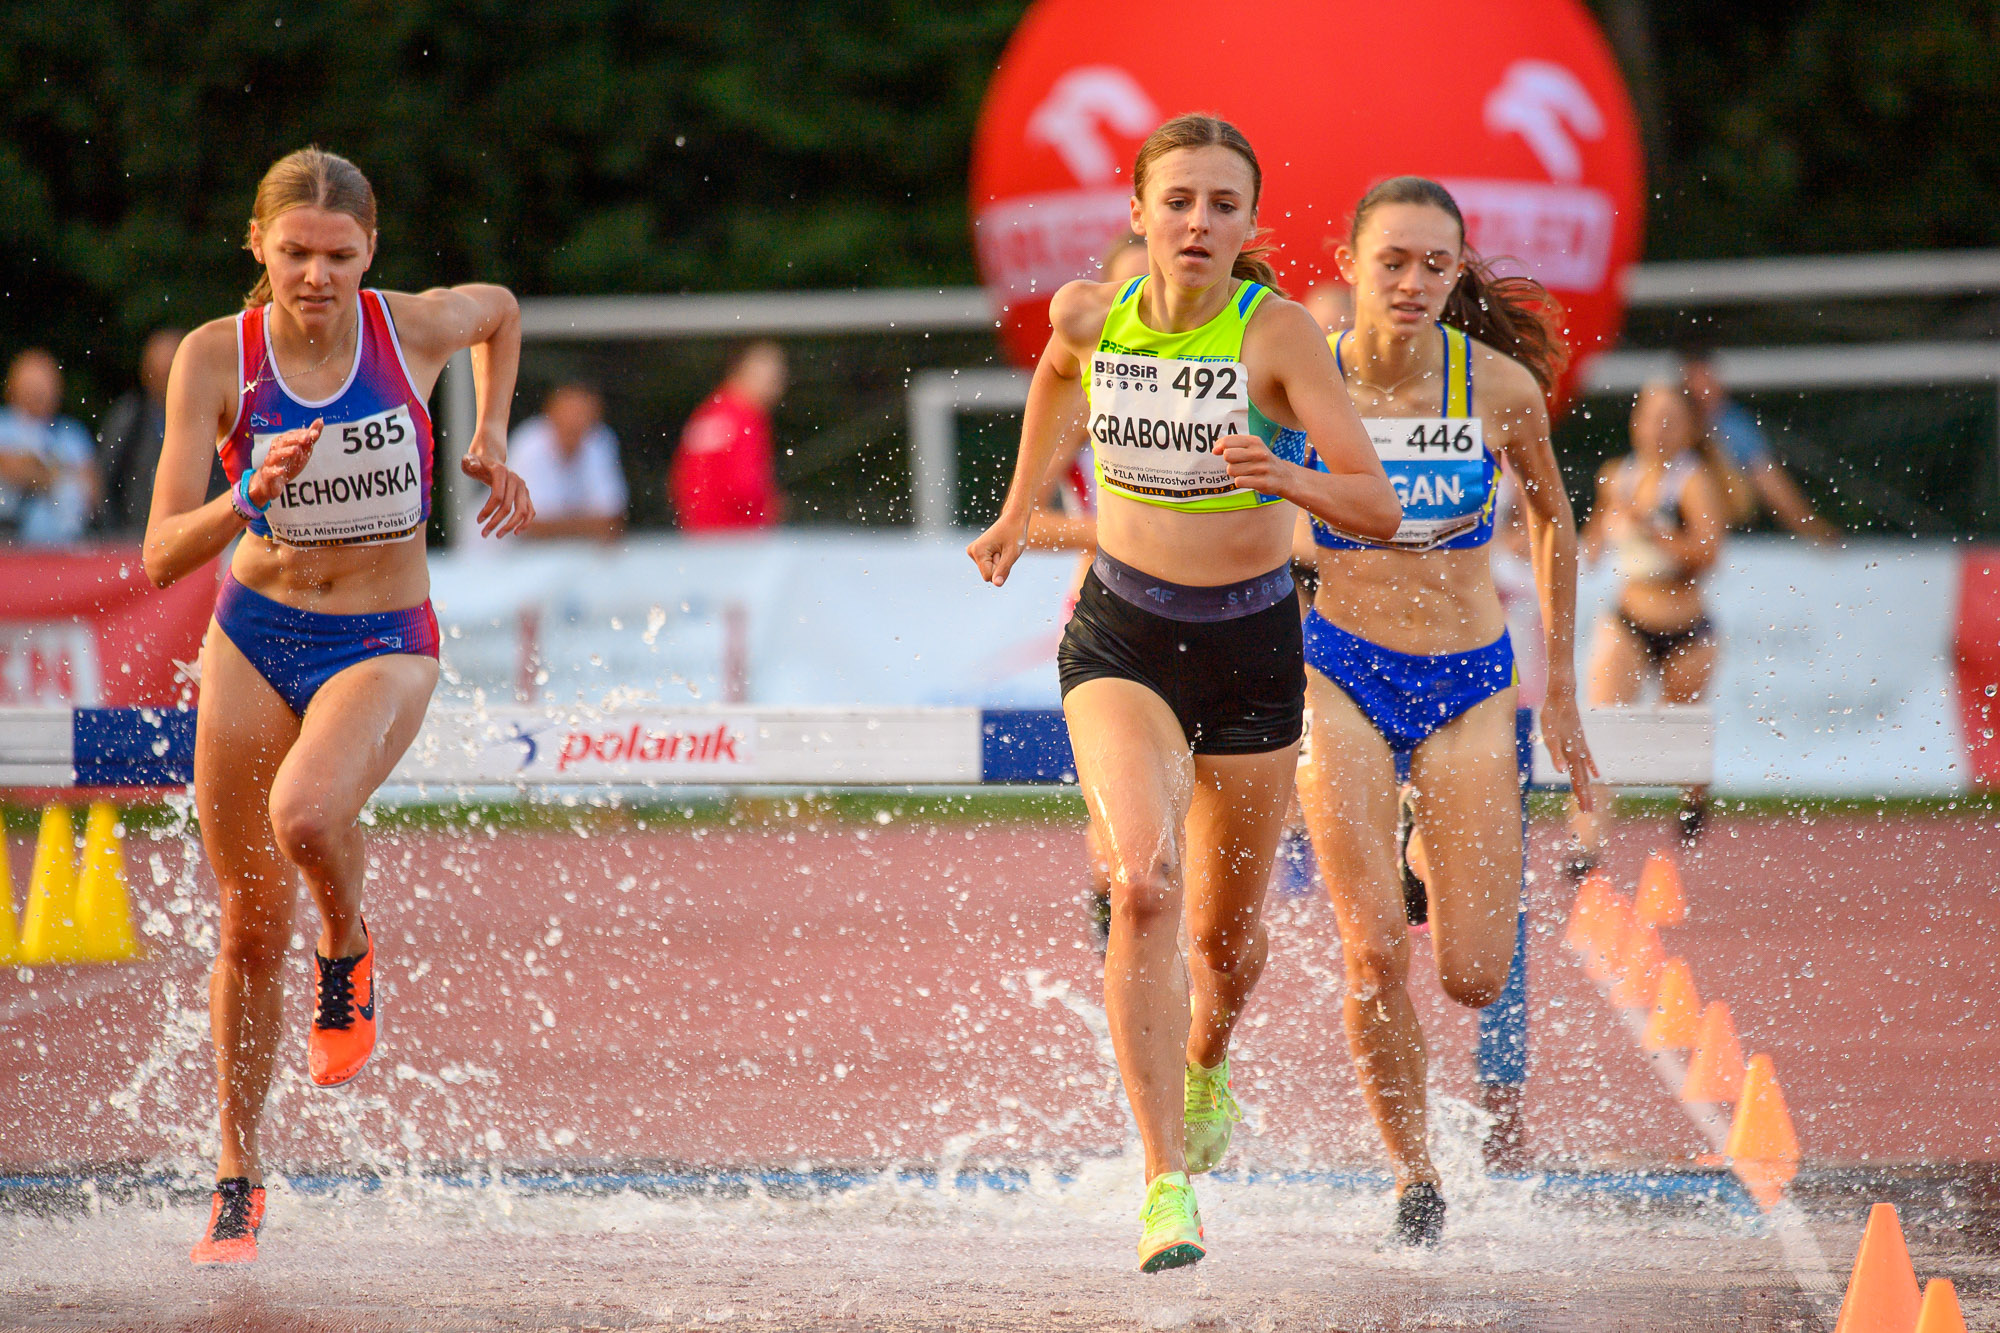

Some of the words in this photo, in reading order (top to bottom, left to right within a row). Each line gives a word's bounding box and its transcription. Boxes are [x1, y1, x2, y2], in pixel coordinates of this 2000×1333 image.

[1095, 360, 1158, 380] BBOSiR
[1172, 366, 1237, 401] 492
[343, 414, 405, 455] 585
[1406, 424, 1473, 453] 446
[269, 462, 418, 509] IECHOWSKA
[1113, 468, 1135, 482] PZLA
[1137, 472, 1196, 486] Mistrzostwa
[1199, 474, 1231, 485] Polski
[286, 527, 311, 538] PZLA
[314, 523, 375, 537] Mistrzostwa
[377, 516, 407, 530] Polski
[556, 723, 737, 772] polanik
